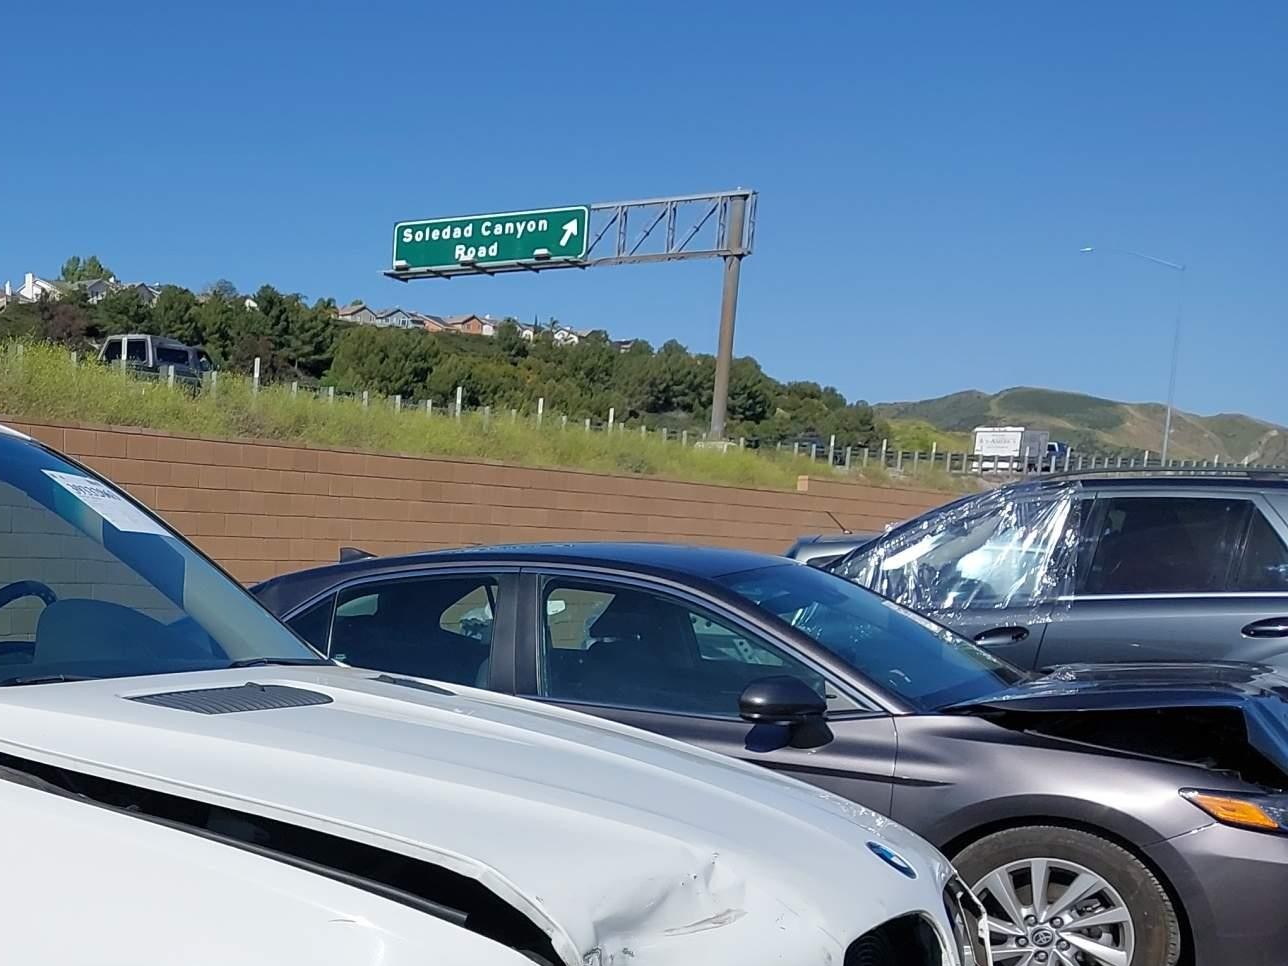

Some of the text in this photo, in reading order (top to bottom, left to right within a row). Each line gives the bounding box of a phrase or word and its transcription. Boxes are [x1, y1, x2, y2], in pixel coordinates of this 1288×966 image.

[402, 219, 548, 242] Soledad Canyon
[455, 242, 498, 259] Road
